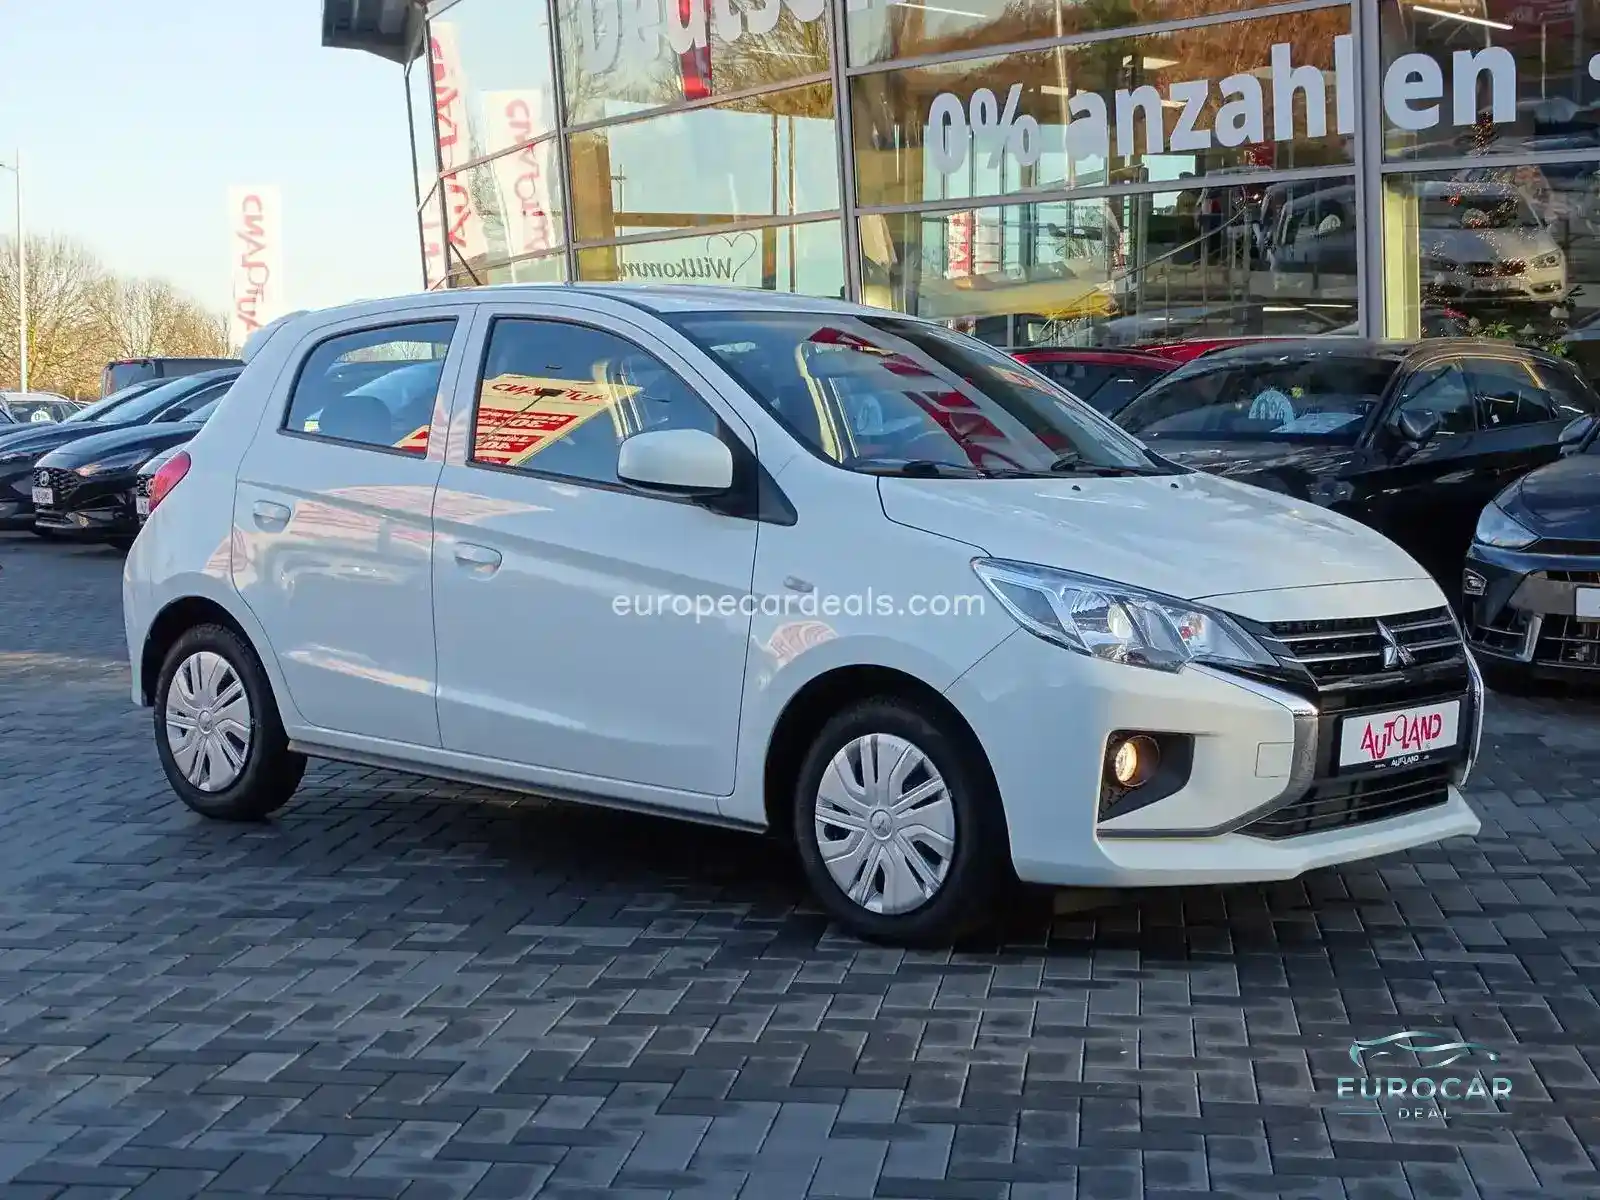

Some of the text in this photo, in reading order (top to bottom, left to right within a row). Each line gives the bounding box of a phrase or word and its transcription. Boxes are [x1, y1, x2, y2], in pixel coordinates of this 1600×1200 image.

[929, 35, 1517, 174] 0% anzahlen
[1360, 714, 1442, 759] AUTOLAND
